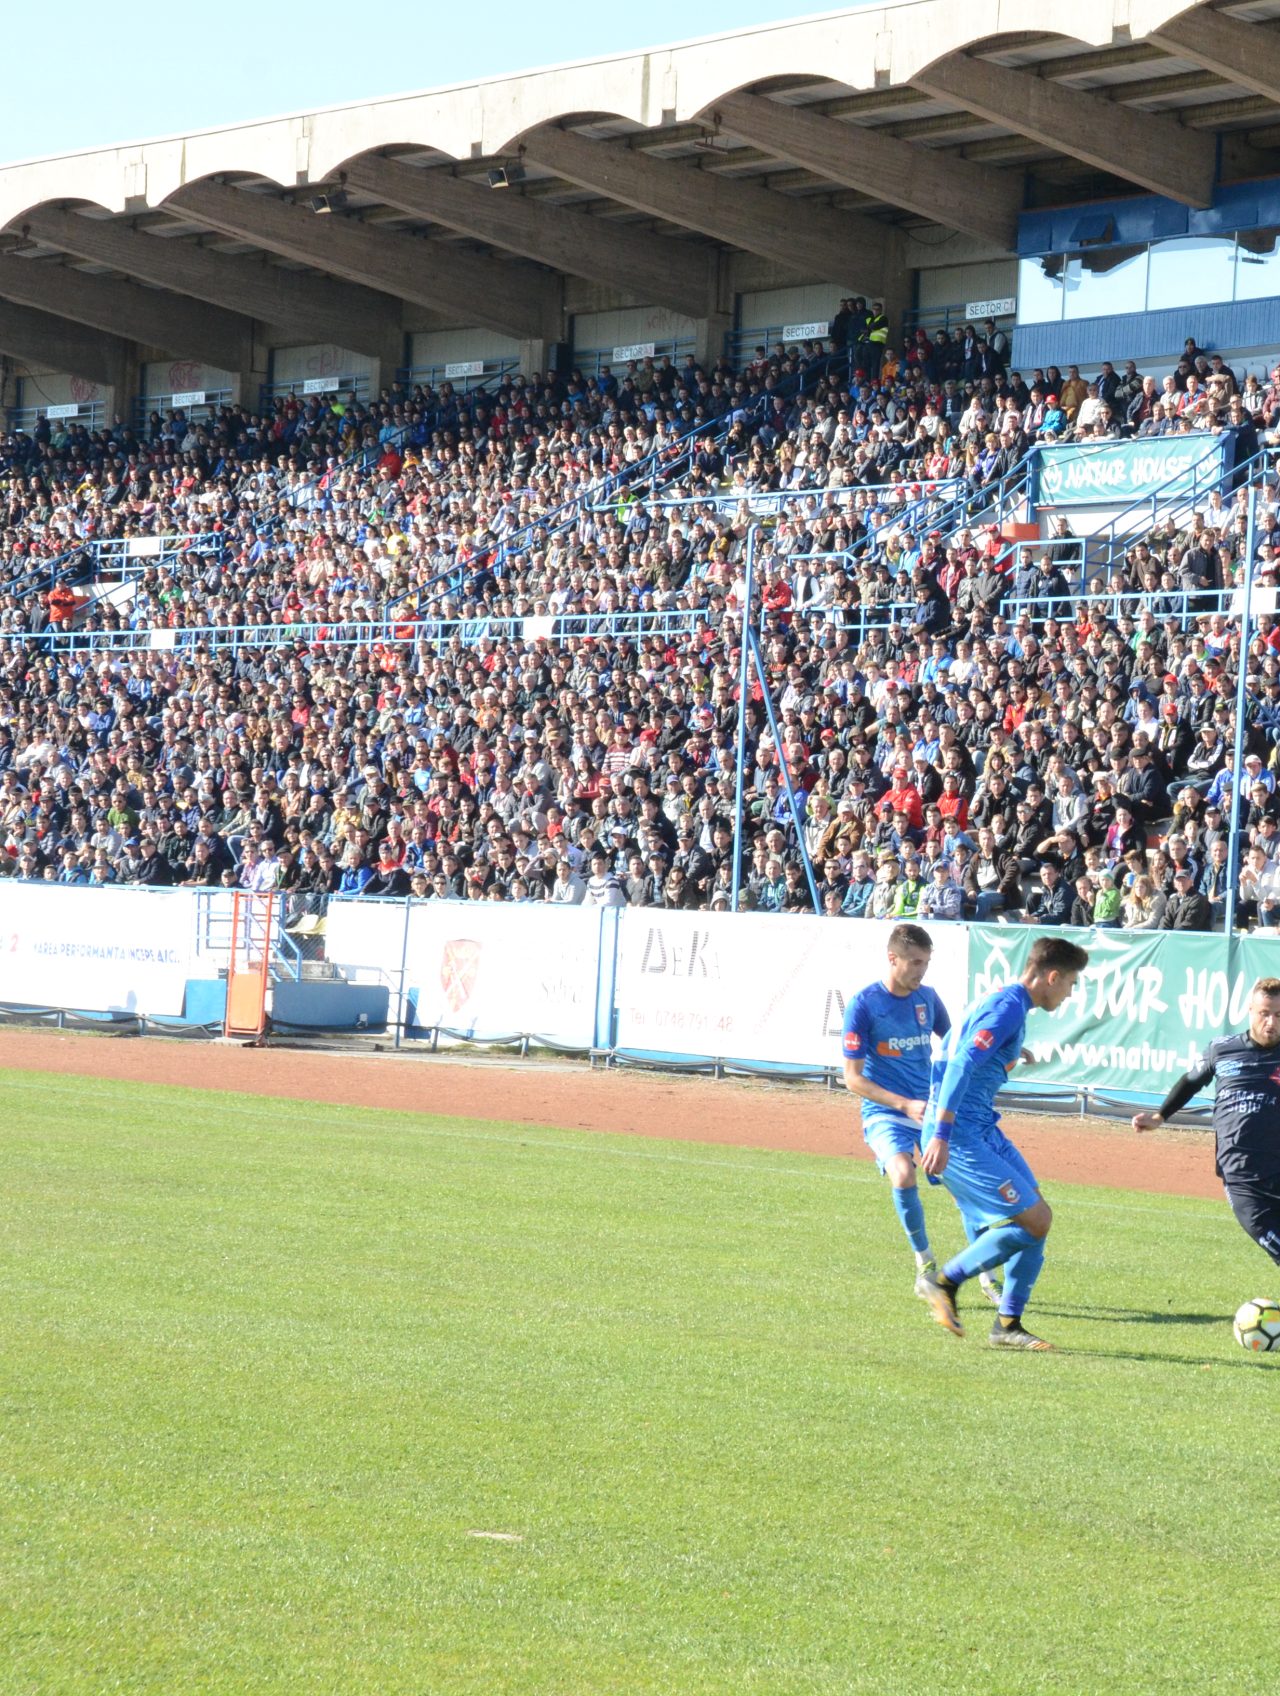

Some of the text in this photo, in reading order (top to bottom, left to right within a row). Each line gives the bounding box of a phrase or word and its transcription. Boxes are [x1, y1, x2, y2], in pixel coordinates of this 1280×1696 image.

[969, 301, 1014, 316] SECTOR C1
[785, 326, 815, 338] SECTOR
[615, 346, 642, 360] SECTOR
[447, 364, 472, 376] SECTOR
[306, 381, 327, 392] SECTOR
[174, 394, 196, 406] SECTOR
[1064, 456, 1193, 488] NATUR HOUSE
